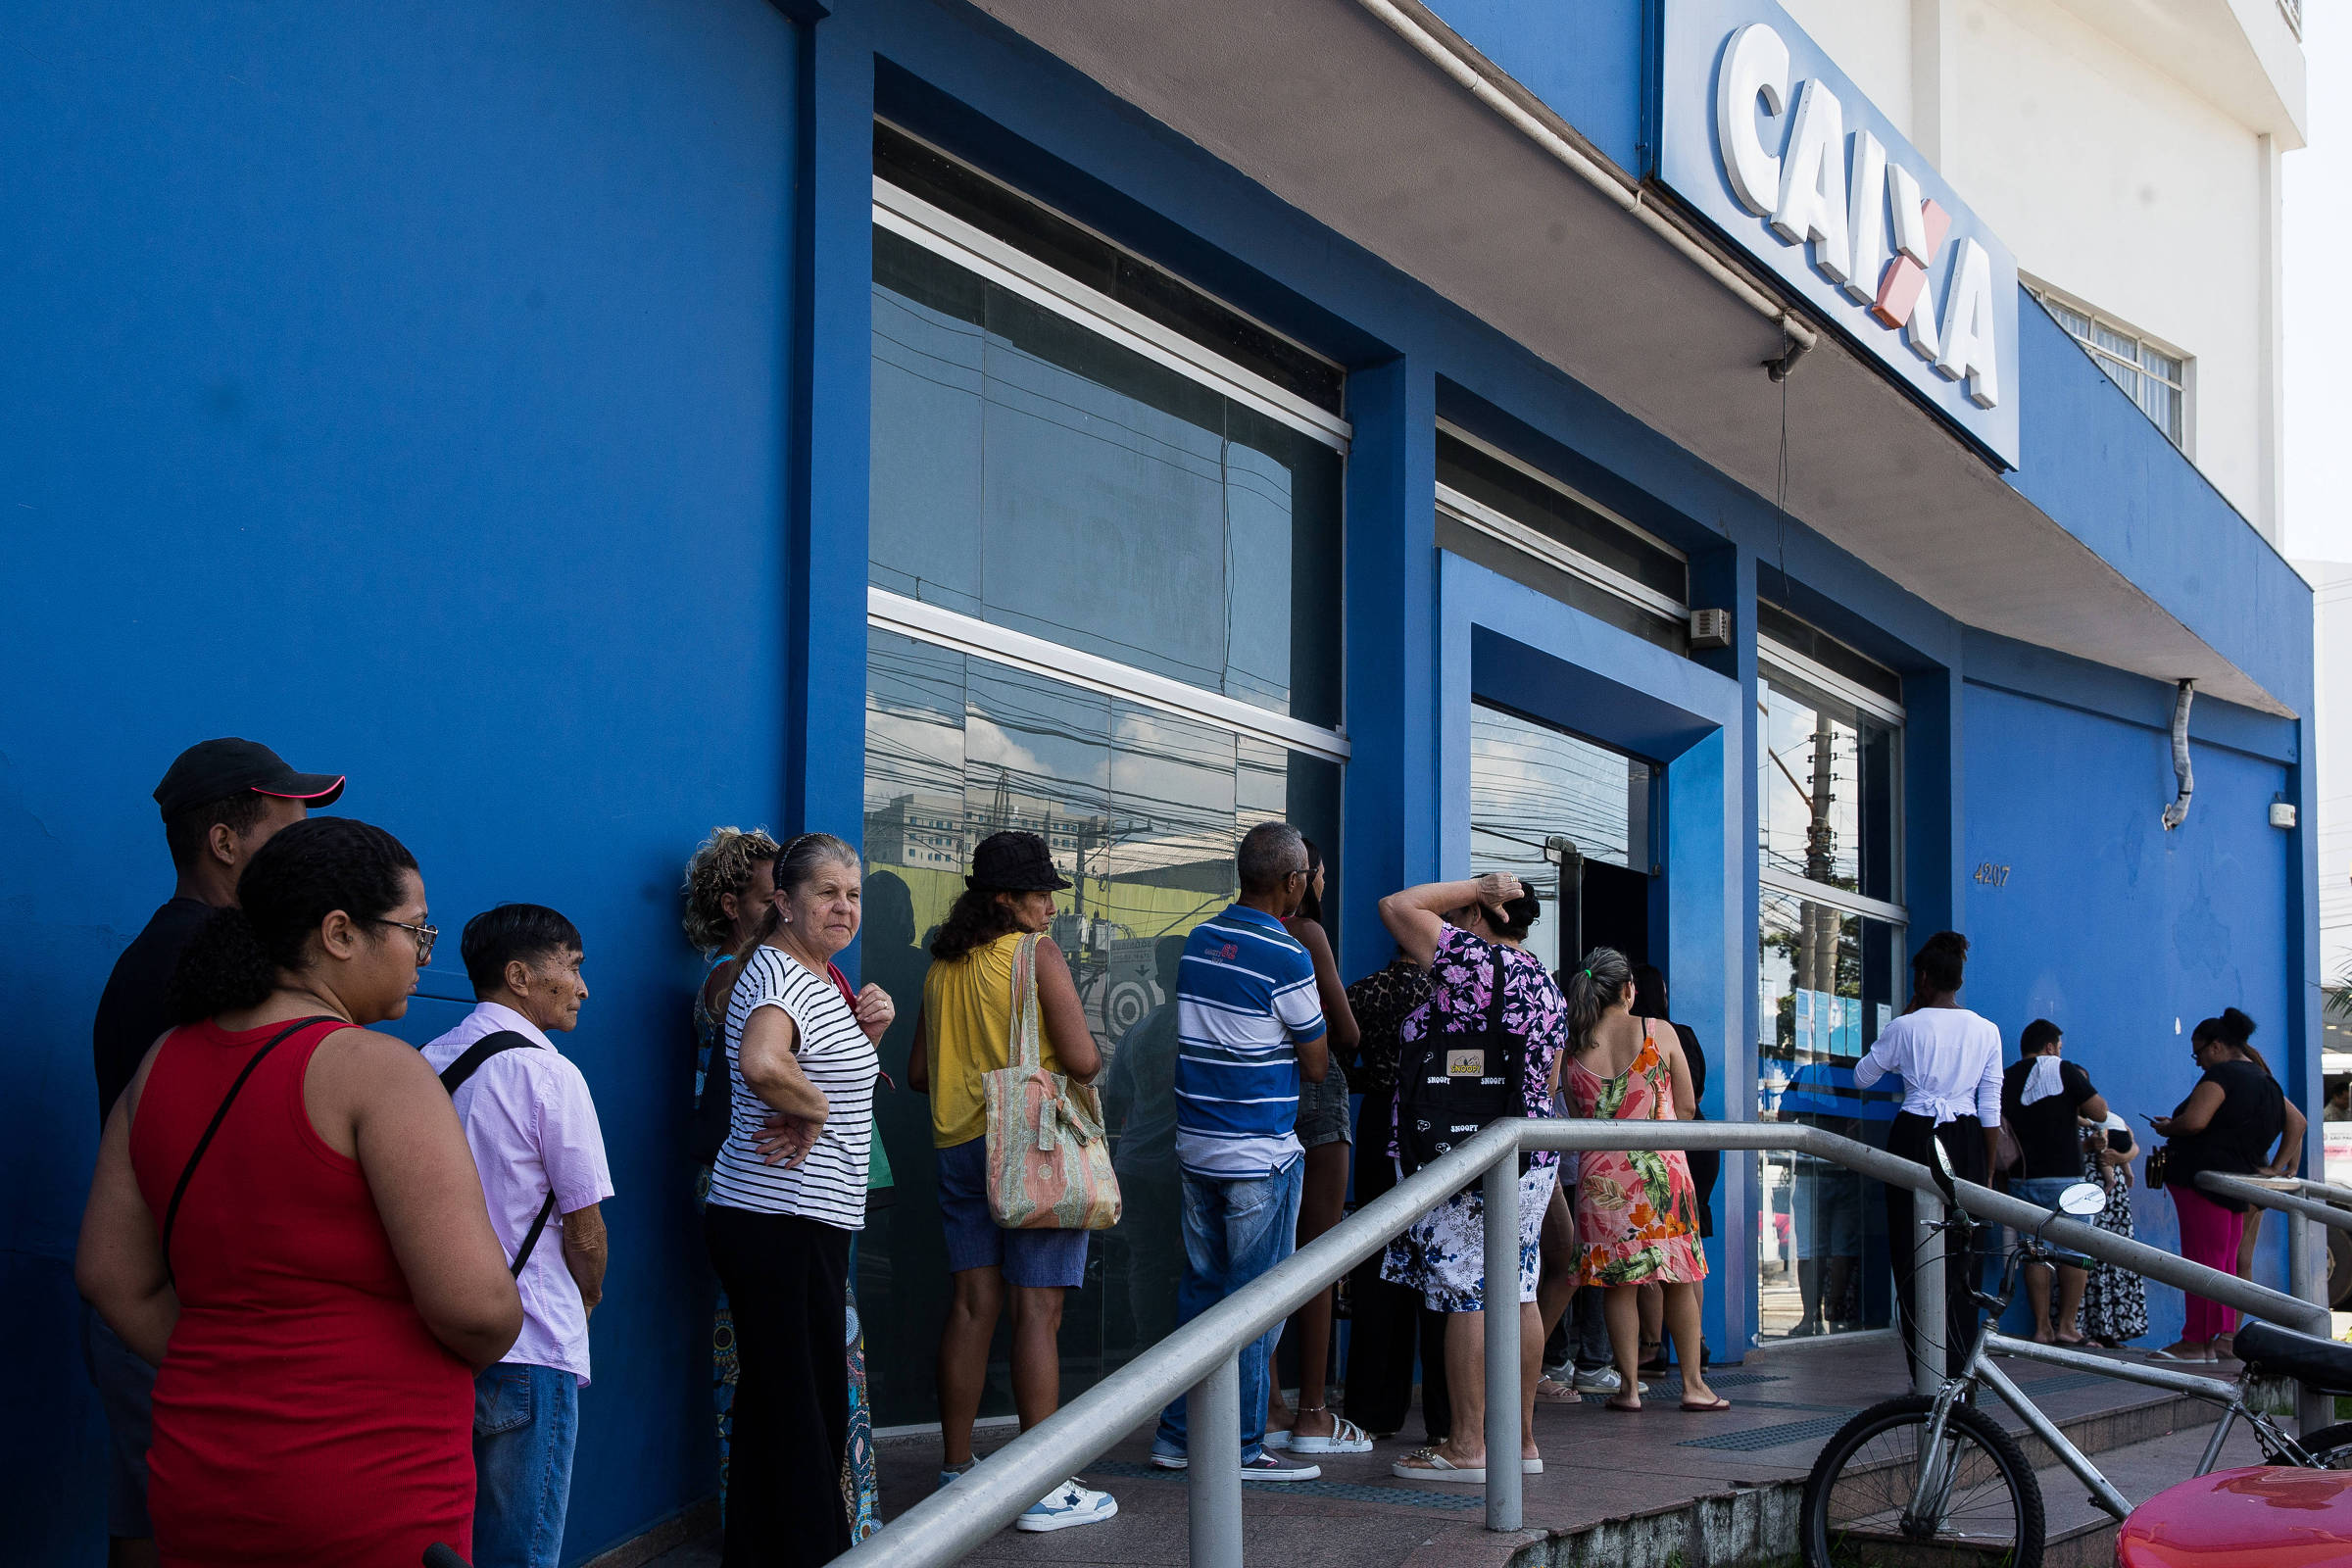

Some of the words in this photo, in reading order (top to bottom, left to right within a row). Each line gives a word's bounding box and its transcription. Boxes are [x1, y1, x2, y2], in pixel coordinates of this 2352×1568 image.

[1717, 23, 1998, 410] CAIXA
[1974, 862, 2010, 887] 4207
[1450, 1065, 1482, 1074] SNOOPY
[1427, 1076, 1451, 1085] SNOOPY
[1450, 1124, 1479, 1133] SNOOPY
